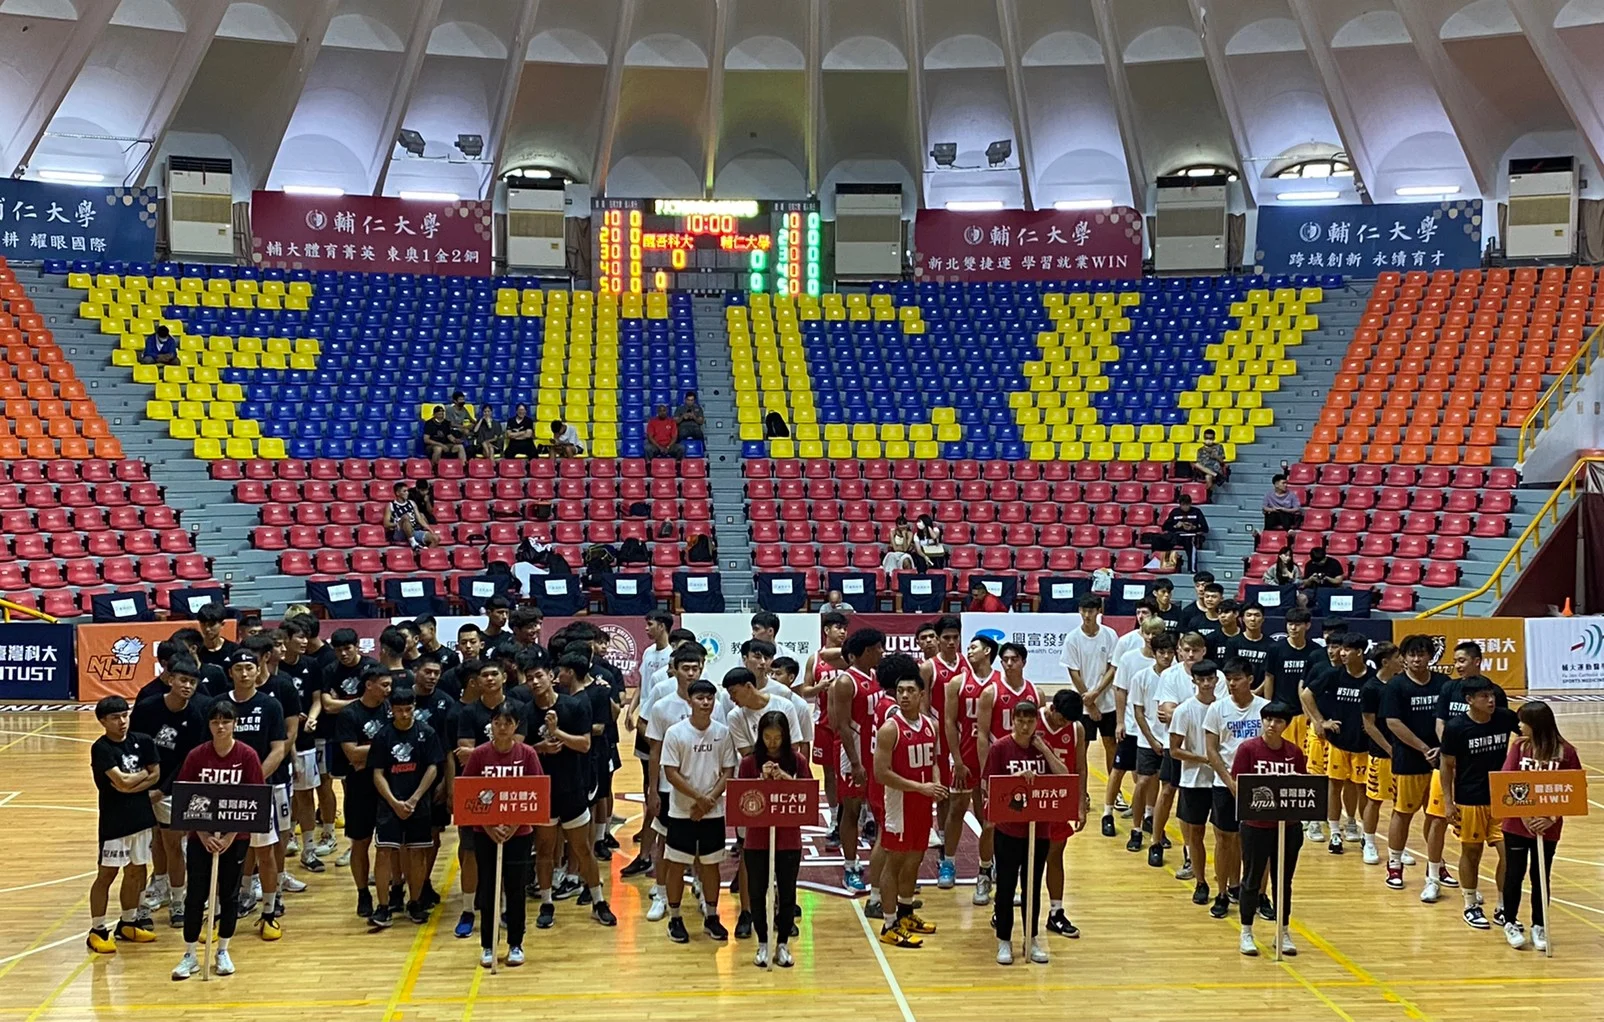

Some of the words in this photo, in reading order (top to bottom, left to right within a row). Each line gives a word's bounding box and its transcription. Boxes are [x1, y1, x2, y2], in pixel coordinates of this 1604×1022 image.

[333, 211, 441, 238] 輔仁大學
[686, 214, 733, 233] 10:00
[1327, 215, 1438, 244] 輔仁大學
[2, 231, 20, 248] 耕
[30, 233, 107, 252] 耀眼國際
[989, 220, 1091, 247] 輔仁大學
[265, 240, 375, 261] 輔大體育菁英
[386, 248, 480, 264] 東奧1金2銅
[1288, 251, 1362, 268] 跨域創新
[1372, 250, 1445, 267] 永續育才
[928, 255, 1012, 272] 新北雙捷運
[1227, 720, 1262, 729] CHINESE
[1232, 730, 1258, 738] TAIPEI
[907, 742, 935, 769] UE
[1006, 759, 1046, 774] FJCU
[198, 768, 243, 784] FJCU
[499, 803, 538, 812] NTSU
[1039, 801, 1059, 809] UE
[1280, 799, 1316, 808] NTUA
[1539, 795, 1569, 804] HWU
[218, 811, 257, 820] NTUST
[770, 805, 806, 814] FJCU
